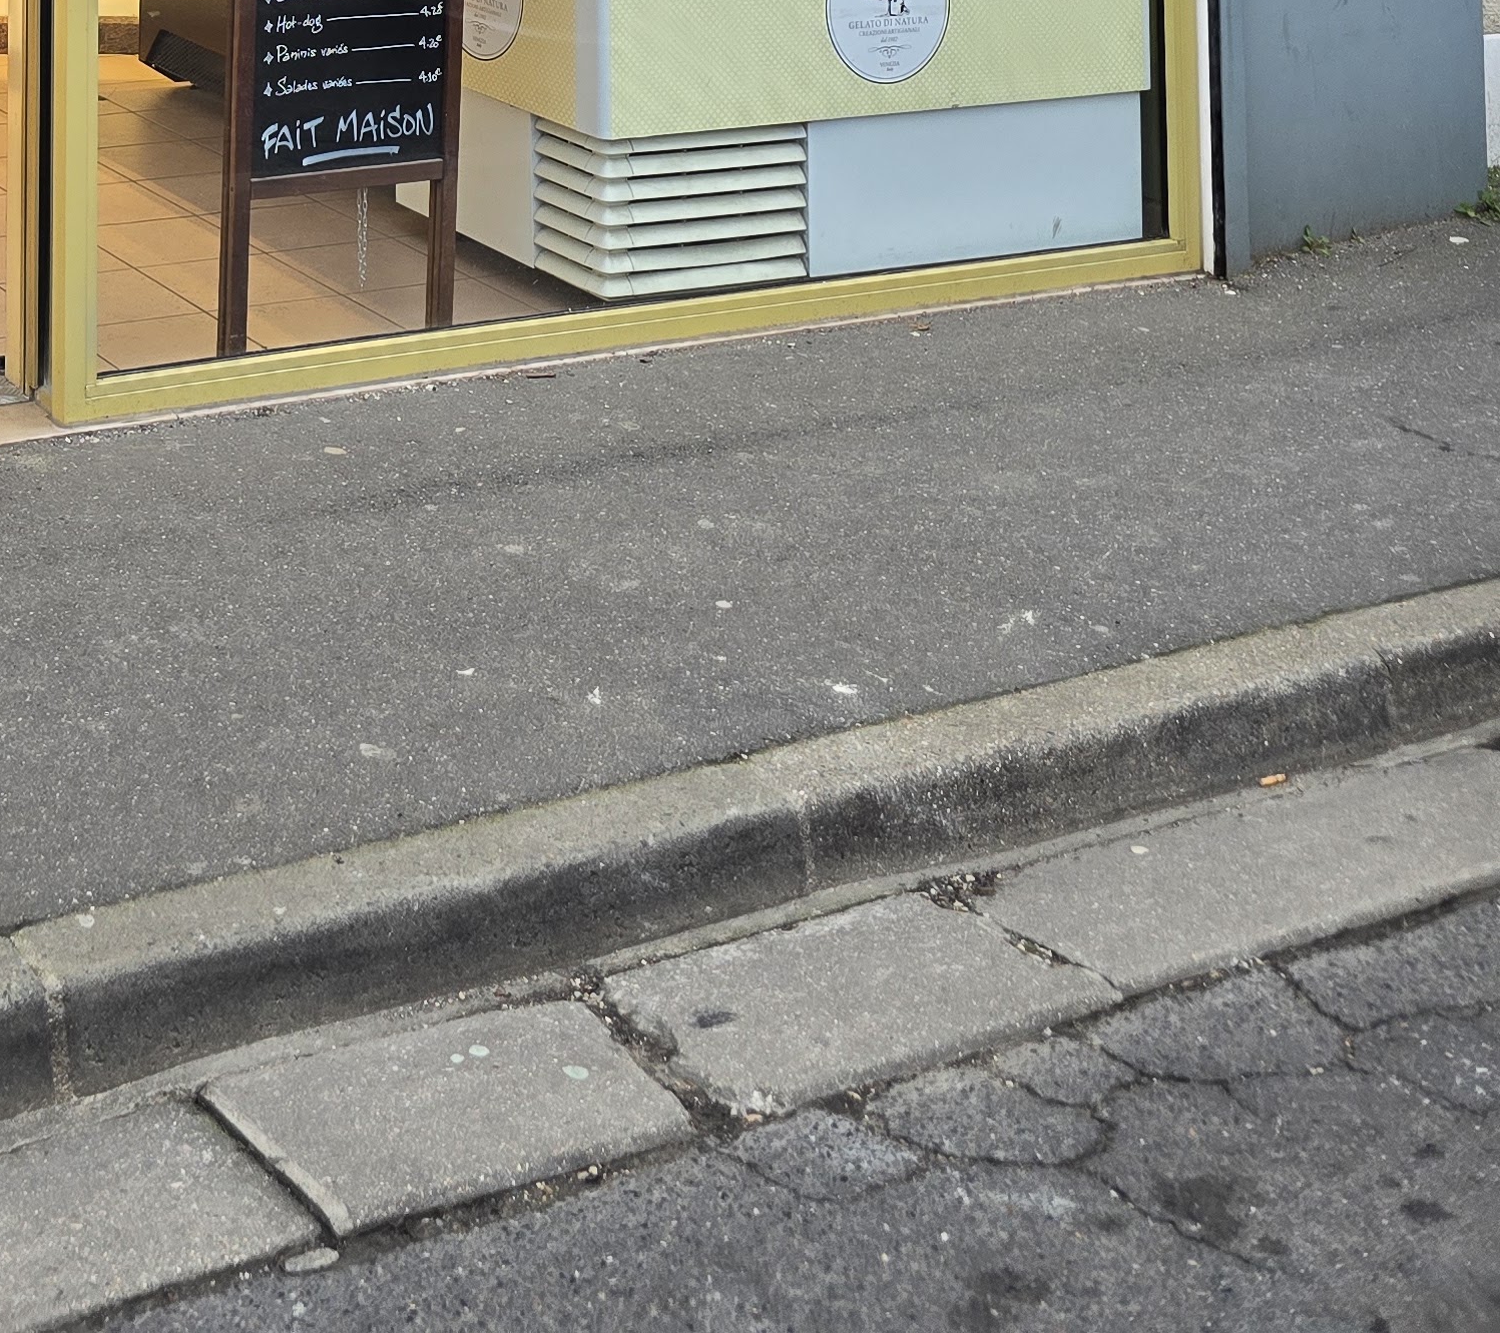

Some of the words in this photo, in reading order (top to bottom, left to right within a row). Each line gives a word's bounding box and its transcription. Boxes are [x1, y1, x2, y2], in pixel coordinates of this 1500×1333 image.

[276, 14, 323, 33] Hot-dog
[848, 19, 882, 29] GELATO
[883, 18, 893, 27] DI
[894, 16, 929, 26] NATURA
[276, 44, 316, 63] Paninis
[320, 43, 349, 57] variés
[274, 76, 318, 96] Salades
